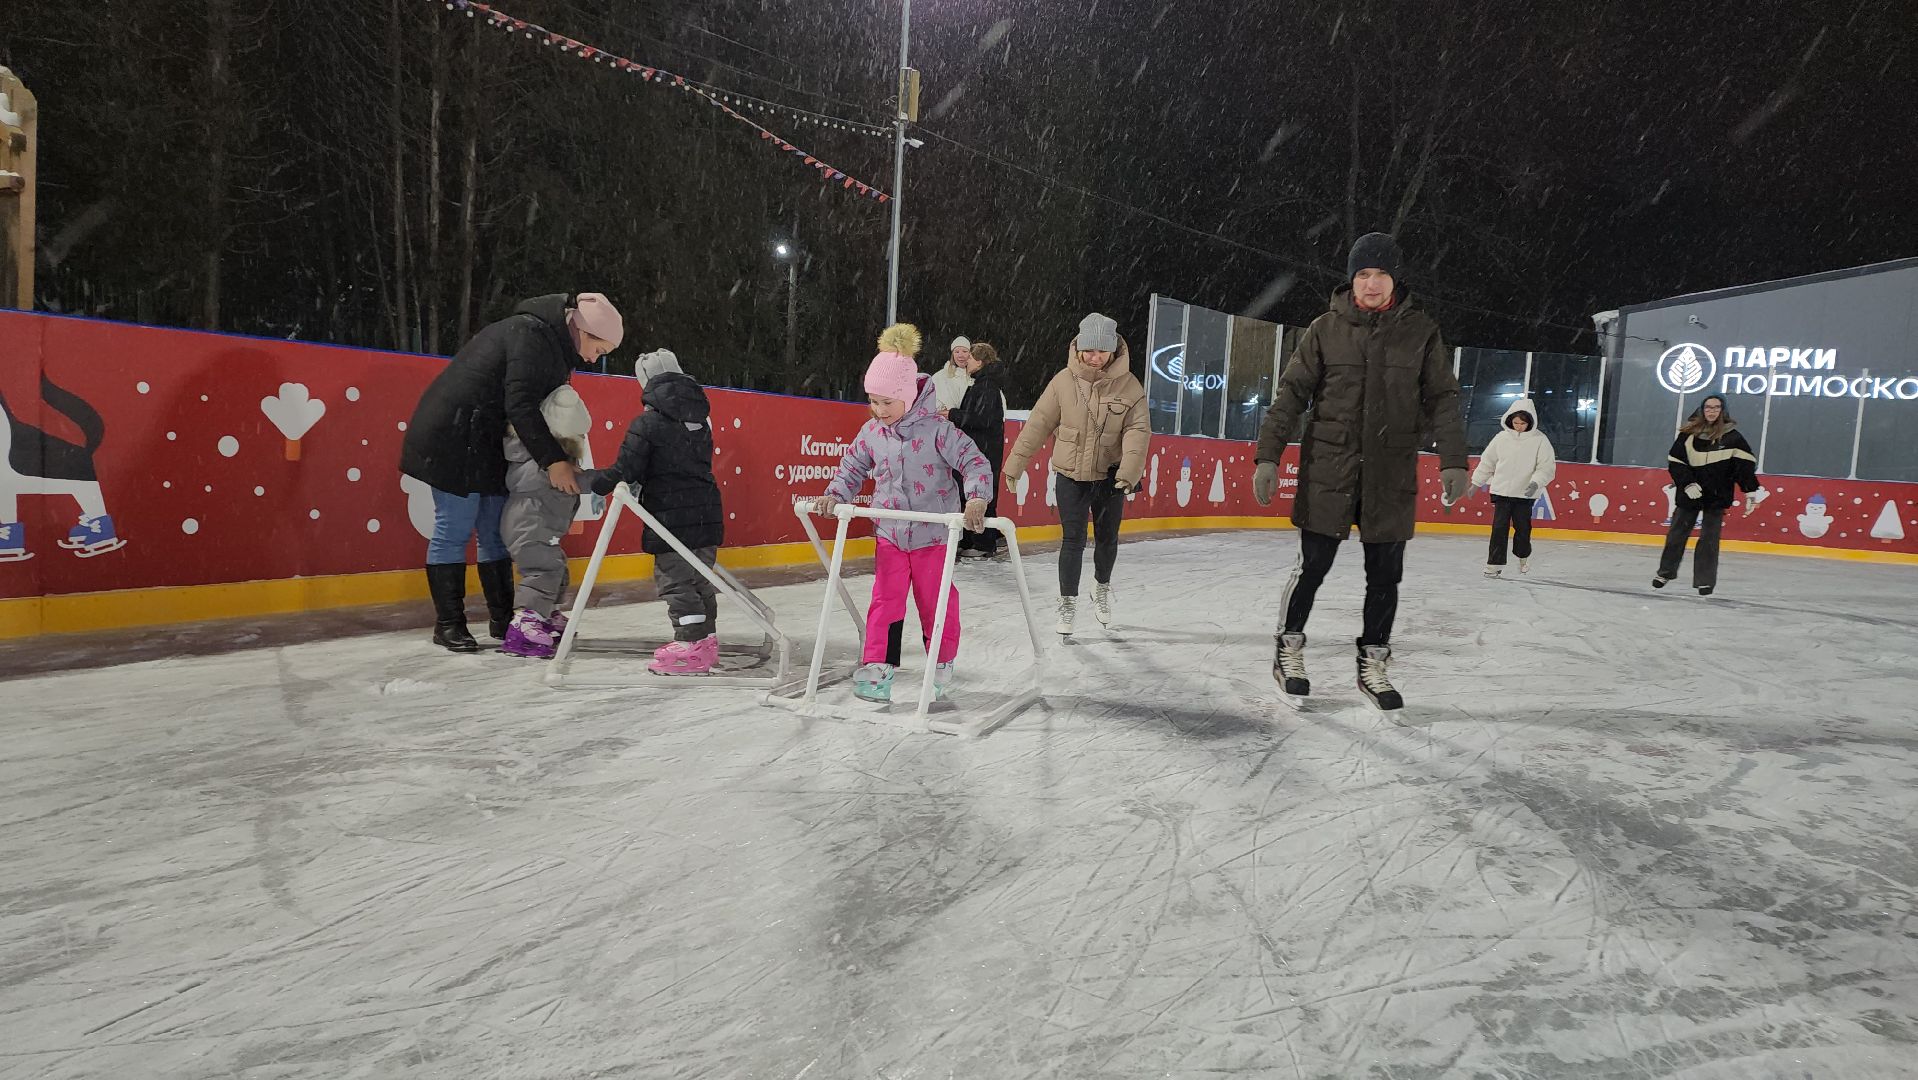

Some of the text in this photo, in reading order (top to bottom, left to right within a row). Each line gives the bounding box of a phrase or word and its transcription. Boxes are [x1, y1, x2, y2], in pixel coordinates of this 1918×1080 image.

[1724, 346, 1837, 370] ПАРКИ
[1721, 373, 1918, 400] ПОДМОСКО
[800, 434, 850, 457] Катайт
[774, 464, 838, 486] с удовол
[1278, 478, 1299, 489] удов
